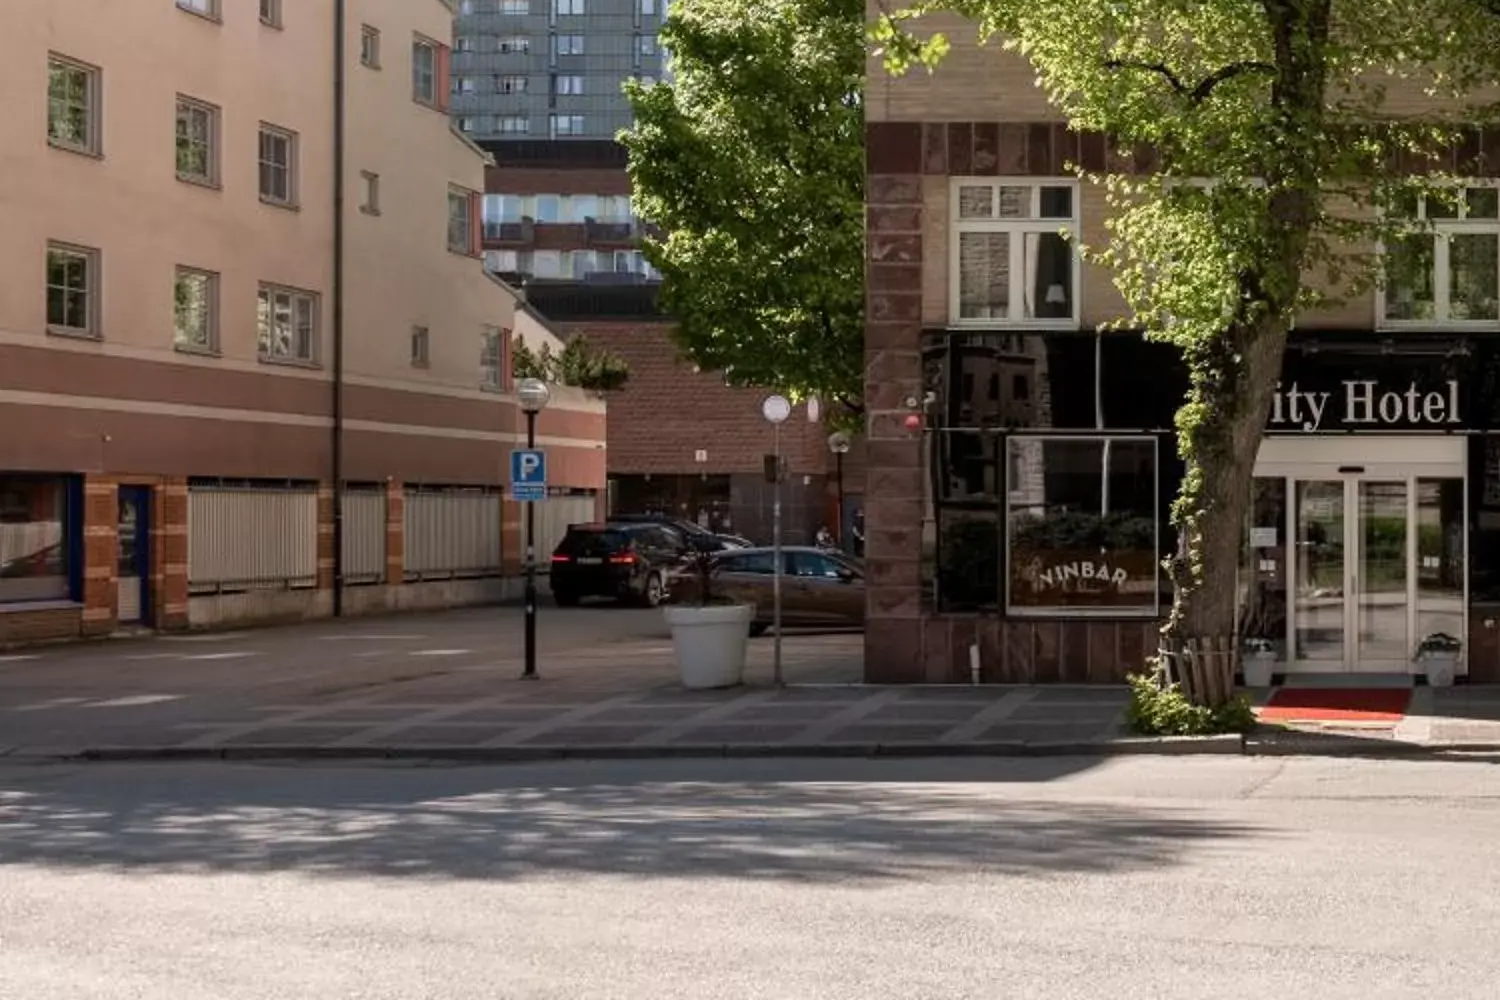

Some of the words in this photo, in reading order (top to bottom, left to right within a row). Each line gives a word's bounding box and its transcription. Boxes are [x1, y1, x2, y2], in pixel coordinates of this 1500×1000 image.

[1270, 381, 1331, 432] ity
[1341, 379, 1463, 423] Hotel
[520, 453, 540, 481] P
[1039, 561, 1128, 586] VINBAR
